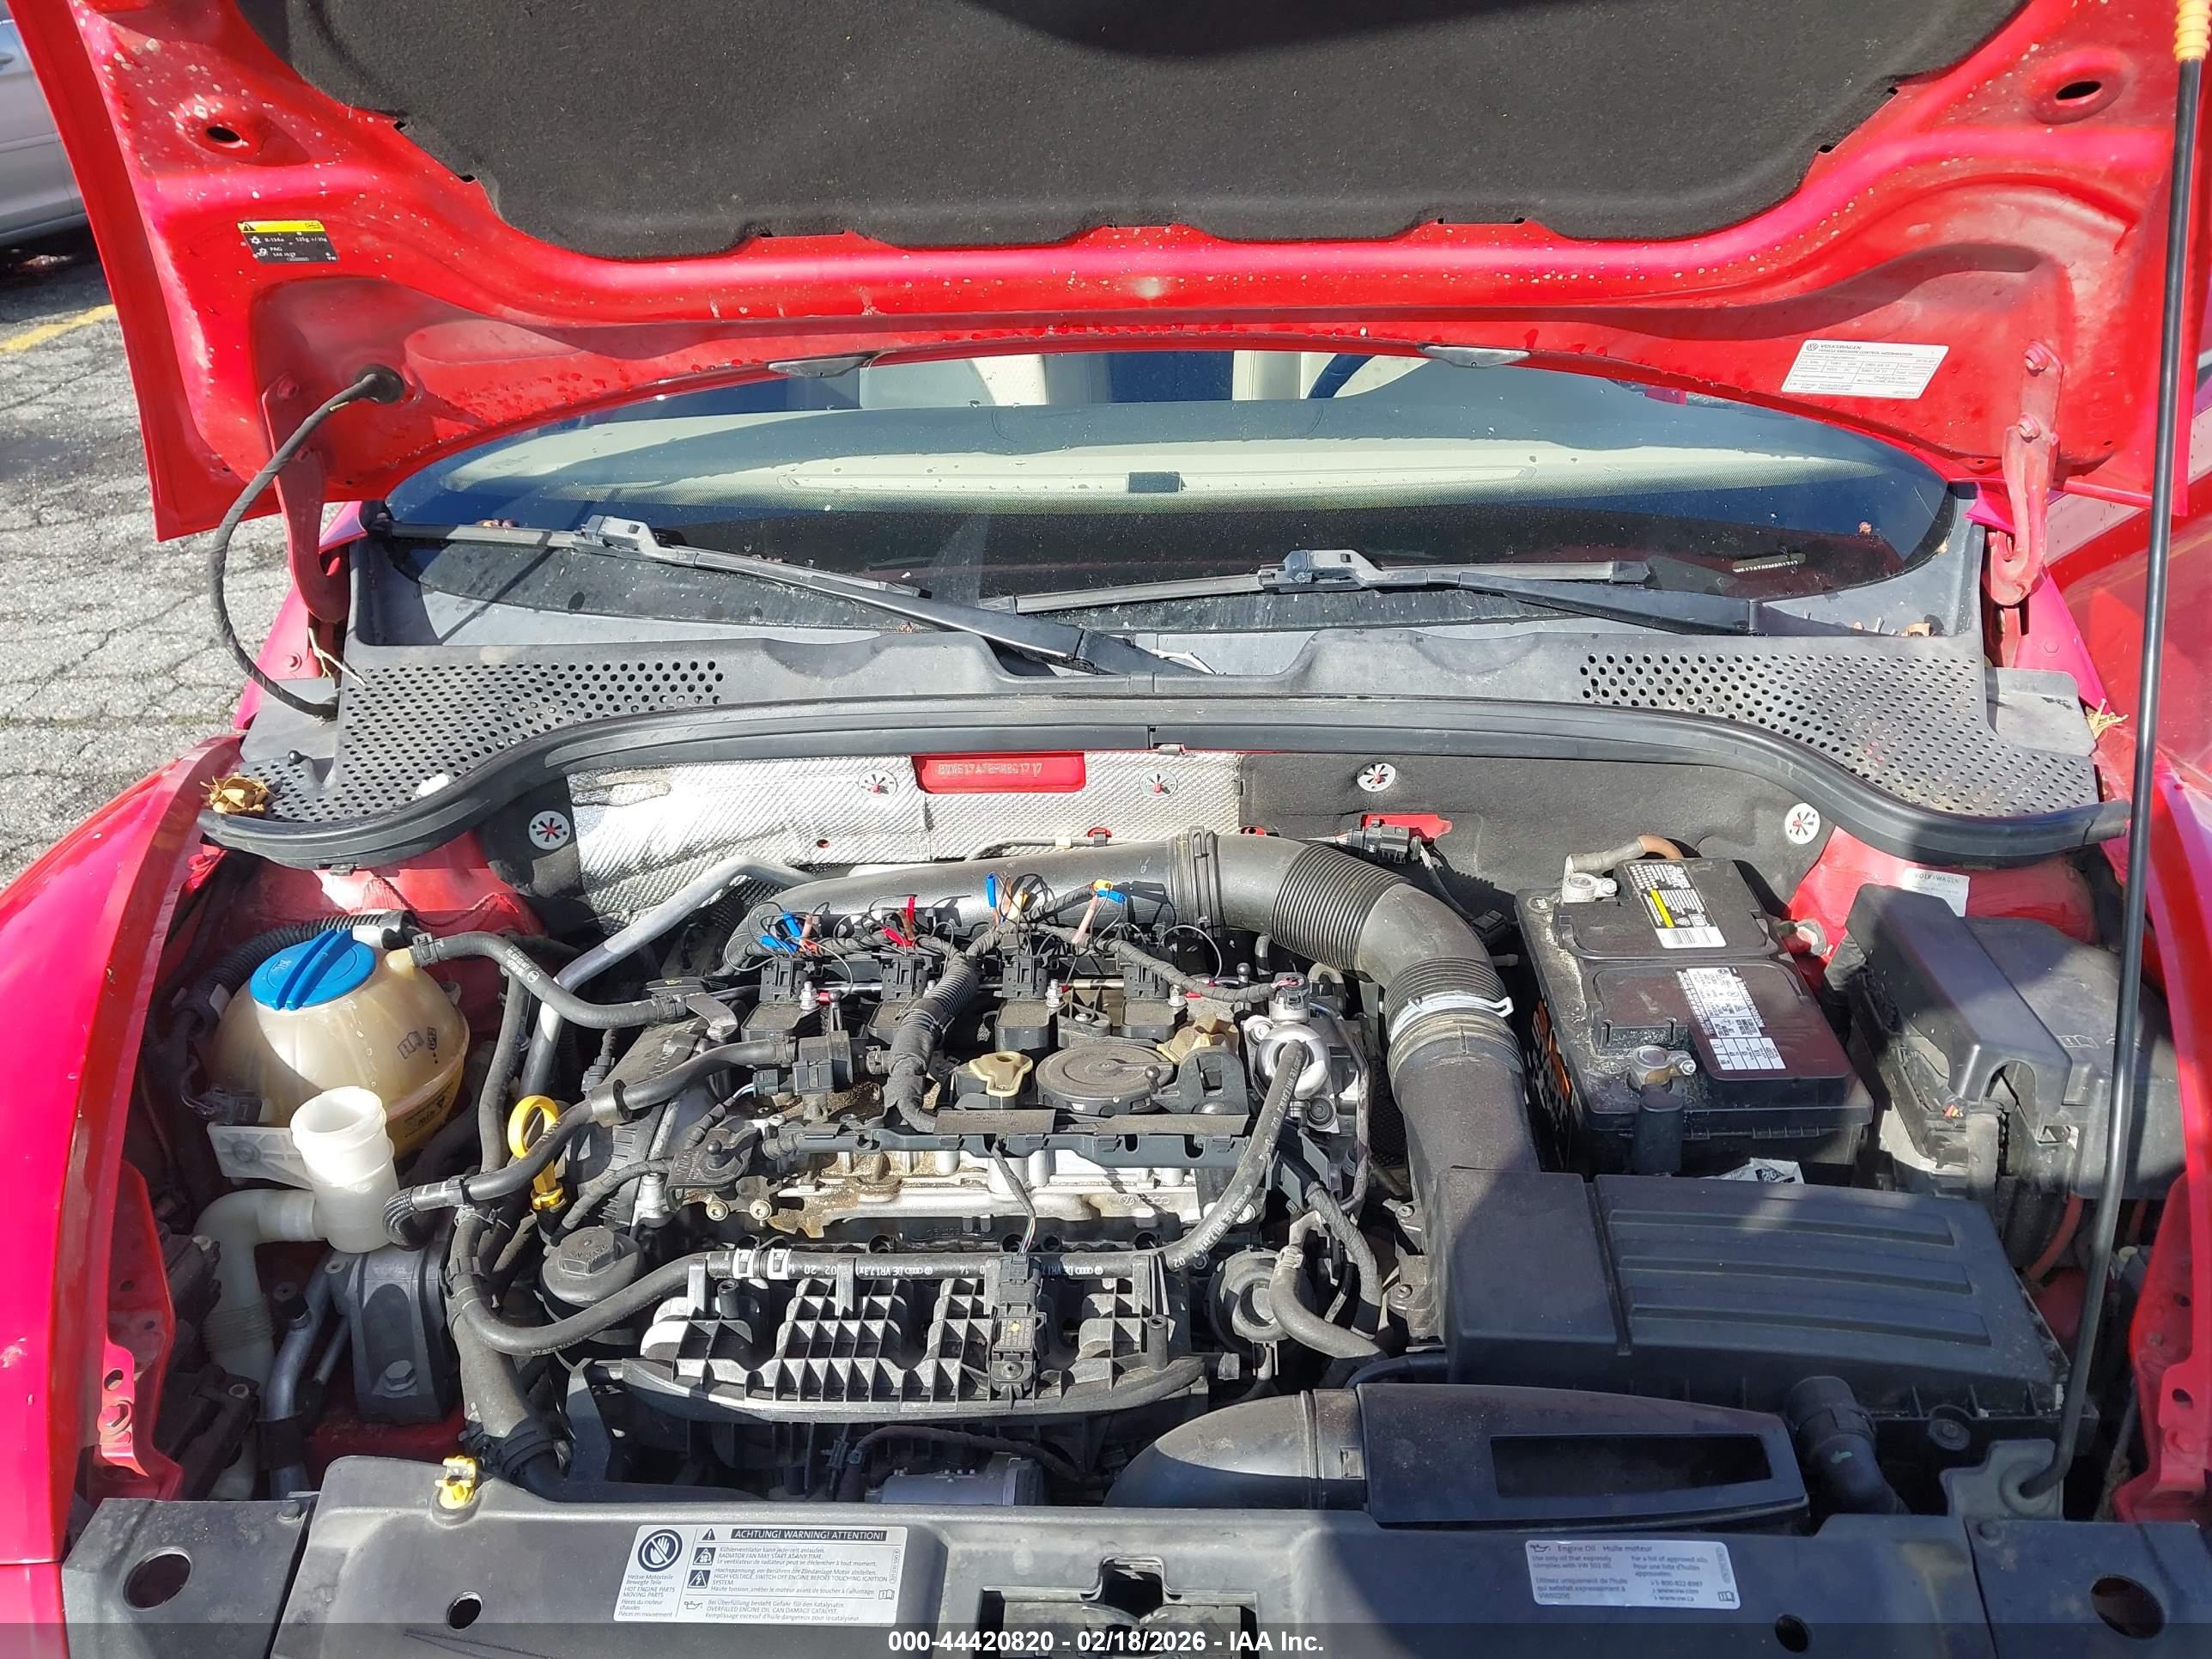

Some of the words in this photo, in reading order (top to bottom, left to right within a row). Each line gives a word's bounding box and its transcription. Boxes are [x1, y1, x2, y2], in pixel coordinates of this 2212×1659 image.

[1172, 1256, 1187, 1268] 02
[804, 1265, 817, 1274] 20
[825, 1265, 836, 1274] 02
[877, 1267, 890, 1276] VRT
[892, 1267, 902, 1276] DE
[960, 1265, 969, 1274] 14
[734, 1530, 781, 1539] ACHTUNG!
[783, 1530, 830, 1540] WARNING!
[830, 1531, 884, 1540] ATTENTION!
